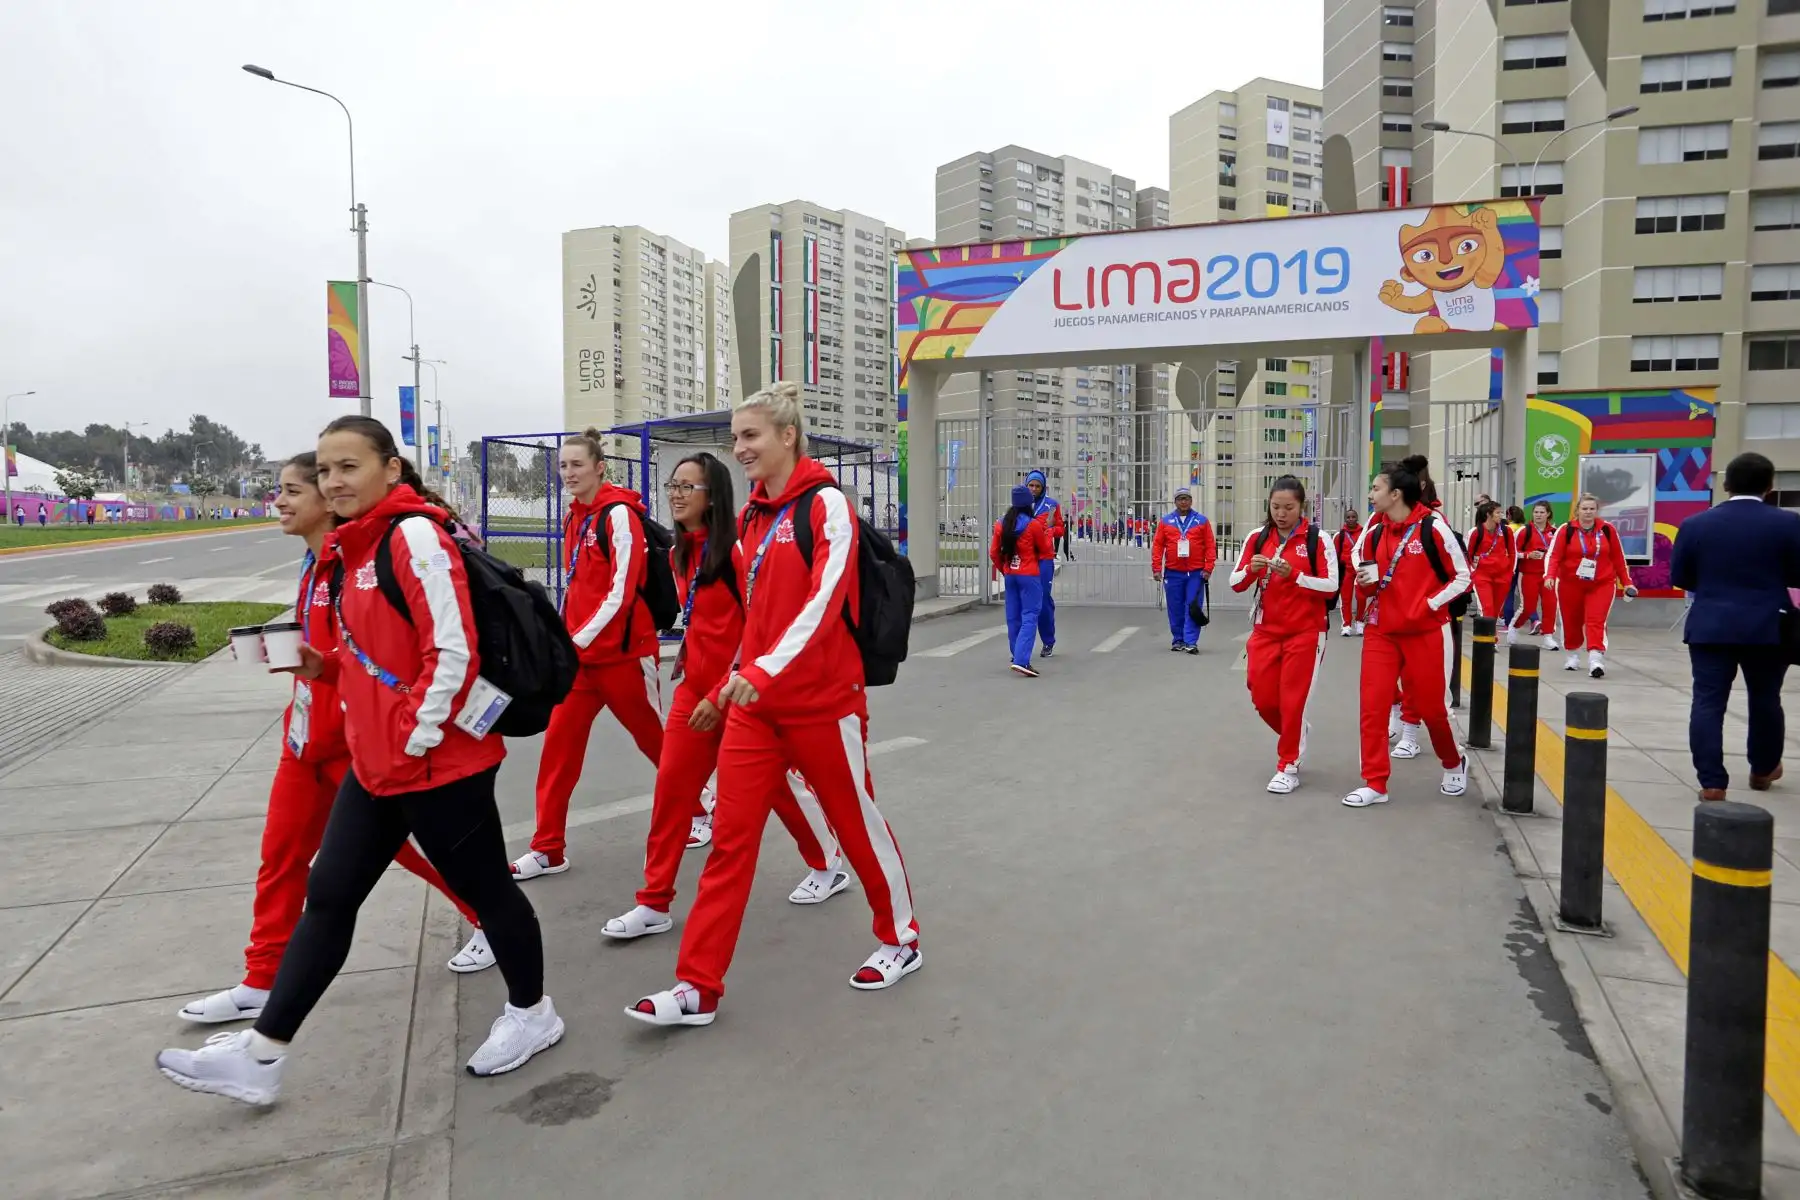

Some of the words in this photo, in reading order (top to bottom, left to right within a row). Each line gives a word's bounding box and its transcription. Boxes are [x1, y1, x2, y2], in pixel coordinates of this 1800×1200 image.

[1206, 246, 1351, 301] 2019
[1053, 315, 1095, 328] JUEGOS
[1097, 309, 1198, 326] PANAMERICANOS
[1200, 309, 1207, 318] Y
[1210, 300, 1350, 319] PARAPANAMERICANOS
[1447, 304, 1475, 317] 2019
[593, 350, 605, 389] 2019
